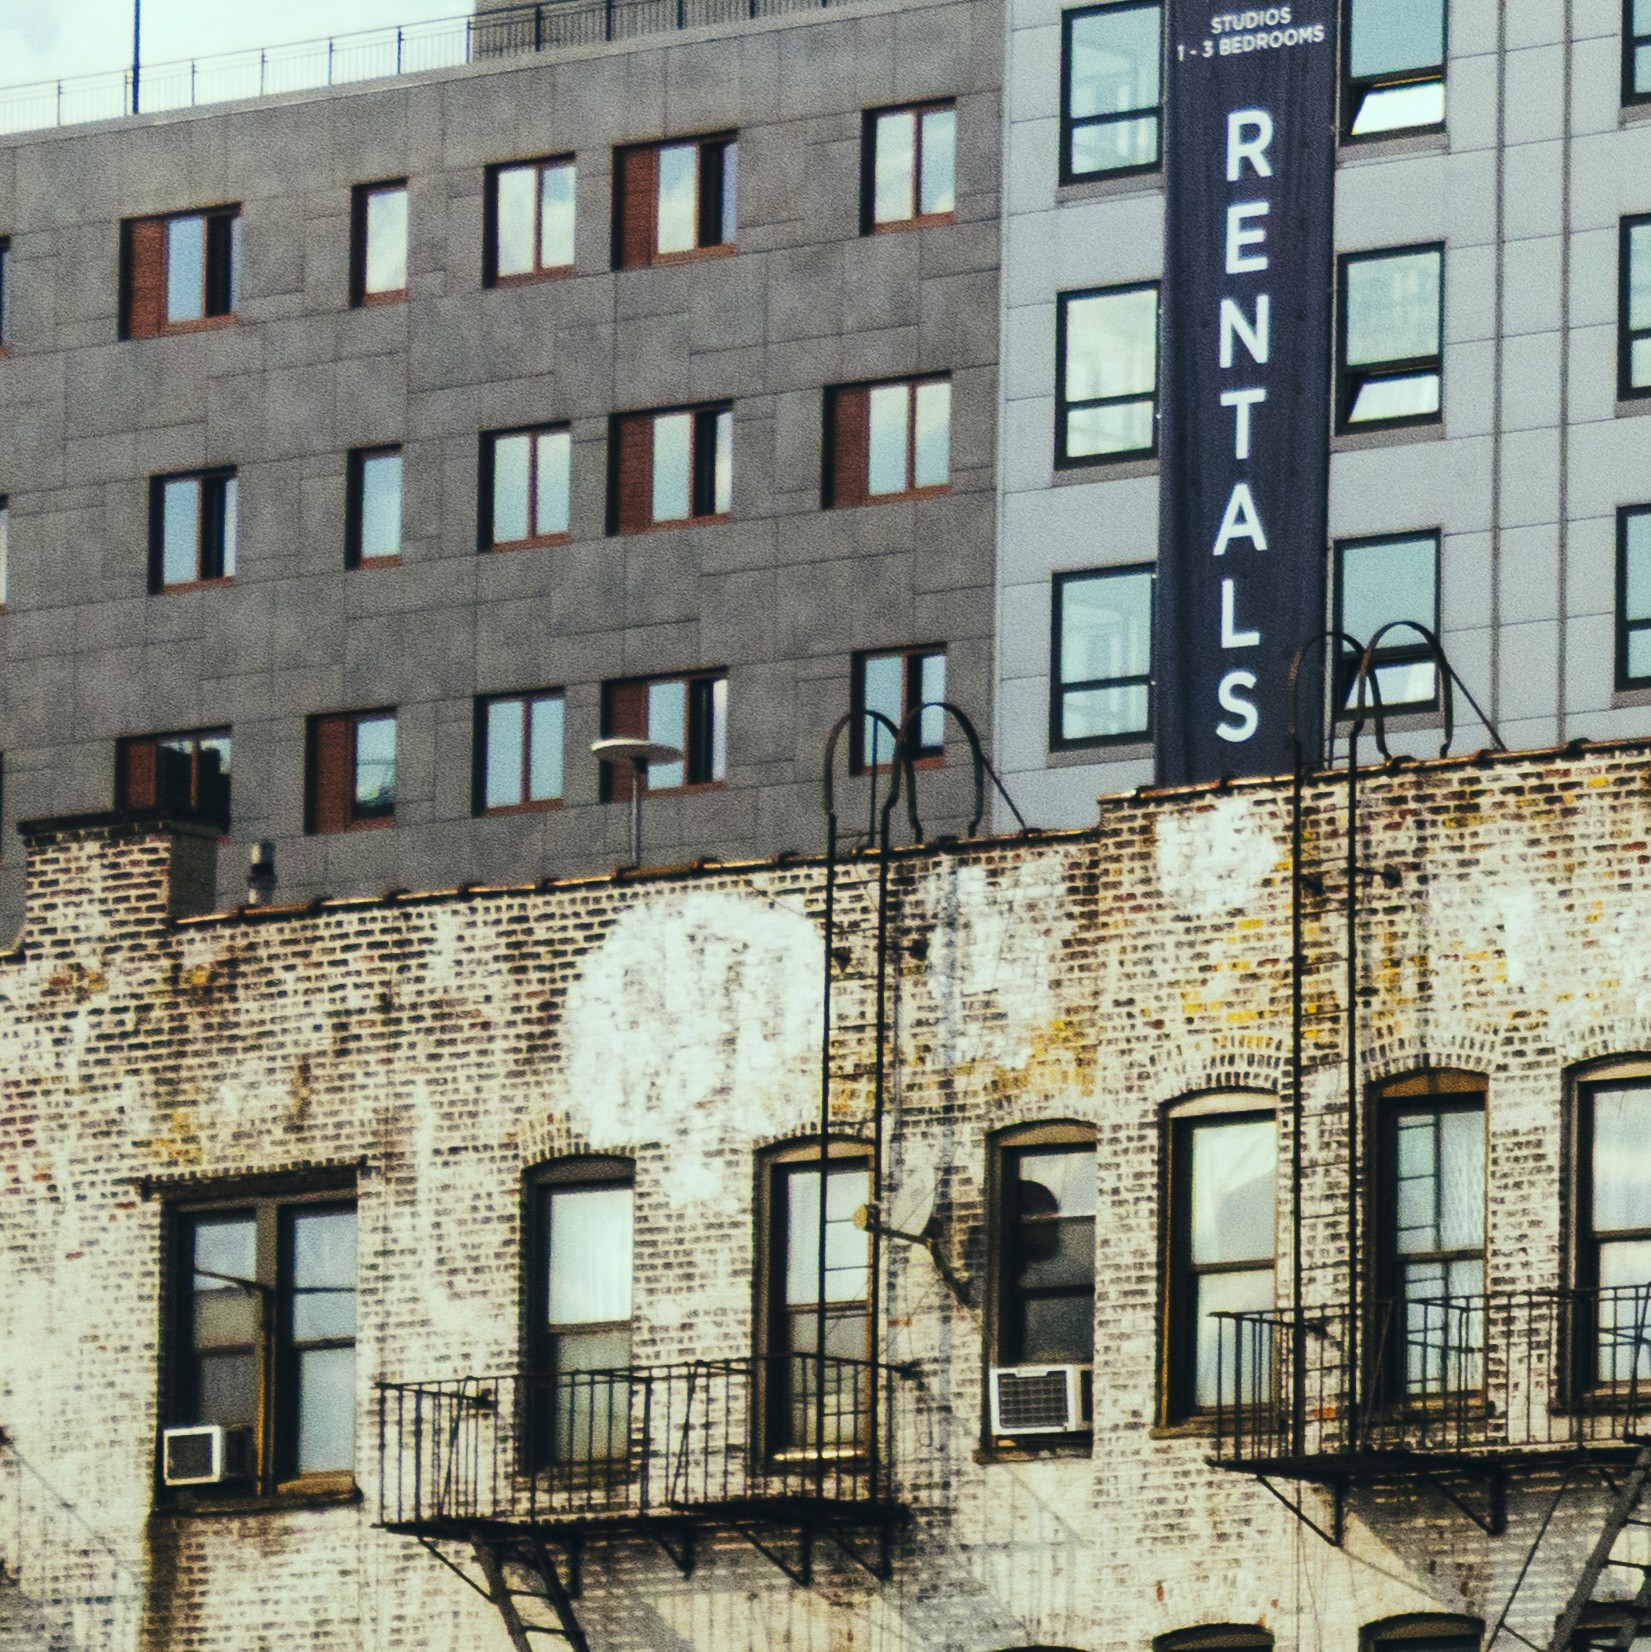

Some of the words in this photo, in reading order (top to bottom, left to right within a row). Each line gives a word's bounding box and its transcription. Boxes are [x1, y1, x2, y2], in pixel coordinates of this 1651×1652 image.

[1211, 7, 1291, 34] STUDIOS
[1202, 40, 1214, 58] 3
[1219, 25, 1325, 55] BEDROOMS
[1213, 108, 1273, 741] RENTALS
